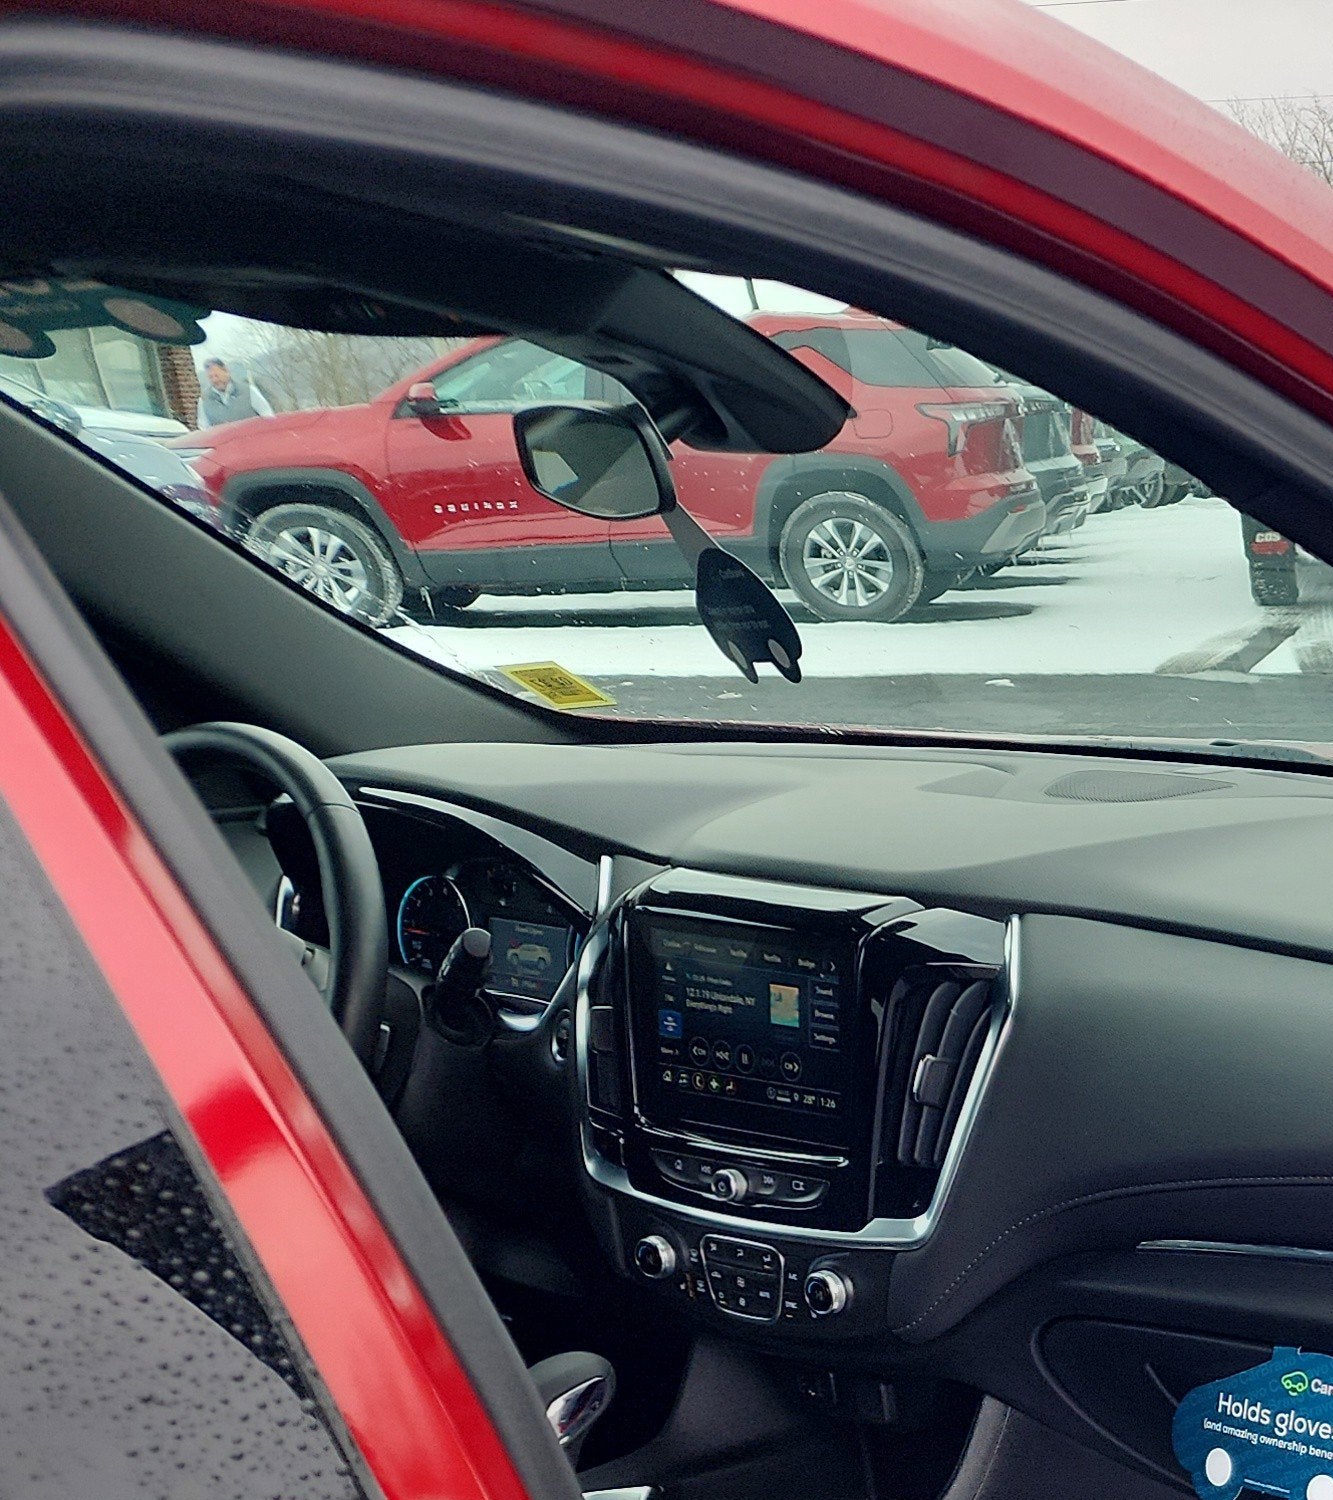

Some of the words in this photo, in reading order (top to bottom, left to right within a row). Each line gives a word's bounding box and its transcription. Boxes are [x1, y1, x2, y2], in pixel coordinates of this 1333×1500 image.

[1217, 1392, 1272, 1425] Holds
[1203, 1417, 1221, 1432] (and
[1222, 1425, 1259, 1445] amazing
[1259, 1436, 1308, 1455] ownership
